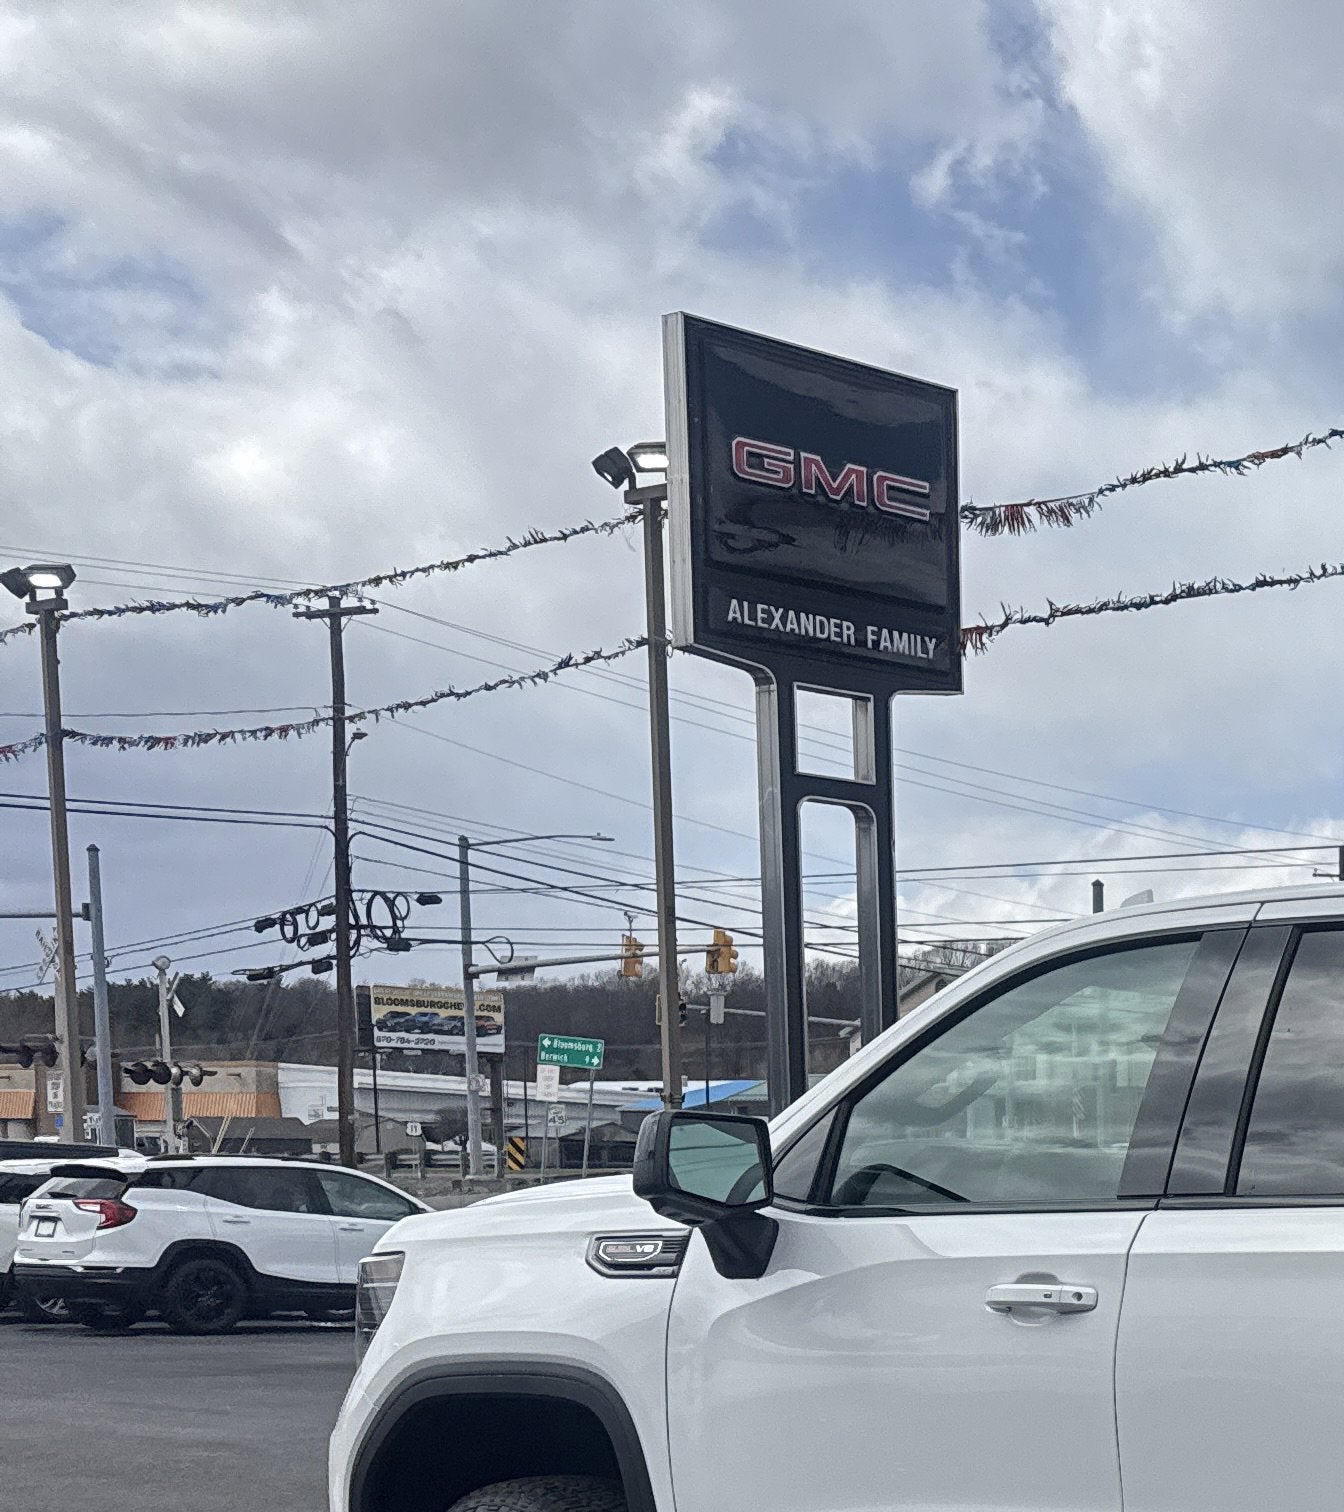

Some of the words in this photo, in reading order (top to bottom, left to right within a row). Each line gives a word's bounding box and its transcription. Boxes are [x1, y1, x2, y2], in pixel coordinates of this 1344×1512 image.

[731, 436, 930, 521] GMC
[727, 598, 856, 647] ALEXANDER
[866, 625, 938, 660] FAMILY
[374, 996, 502, 1014] BLOOMSBURGCHE.COM
[553, 1038, 593, 1053] Bloomsburg
